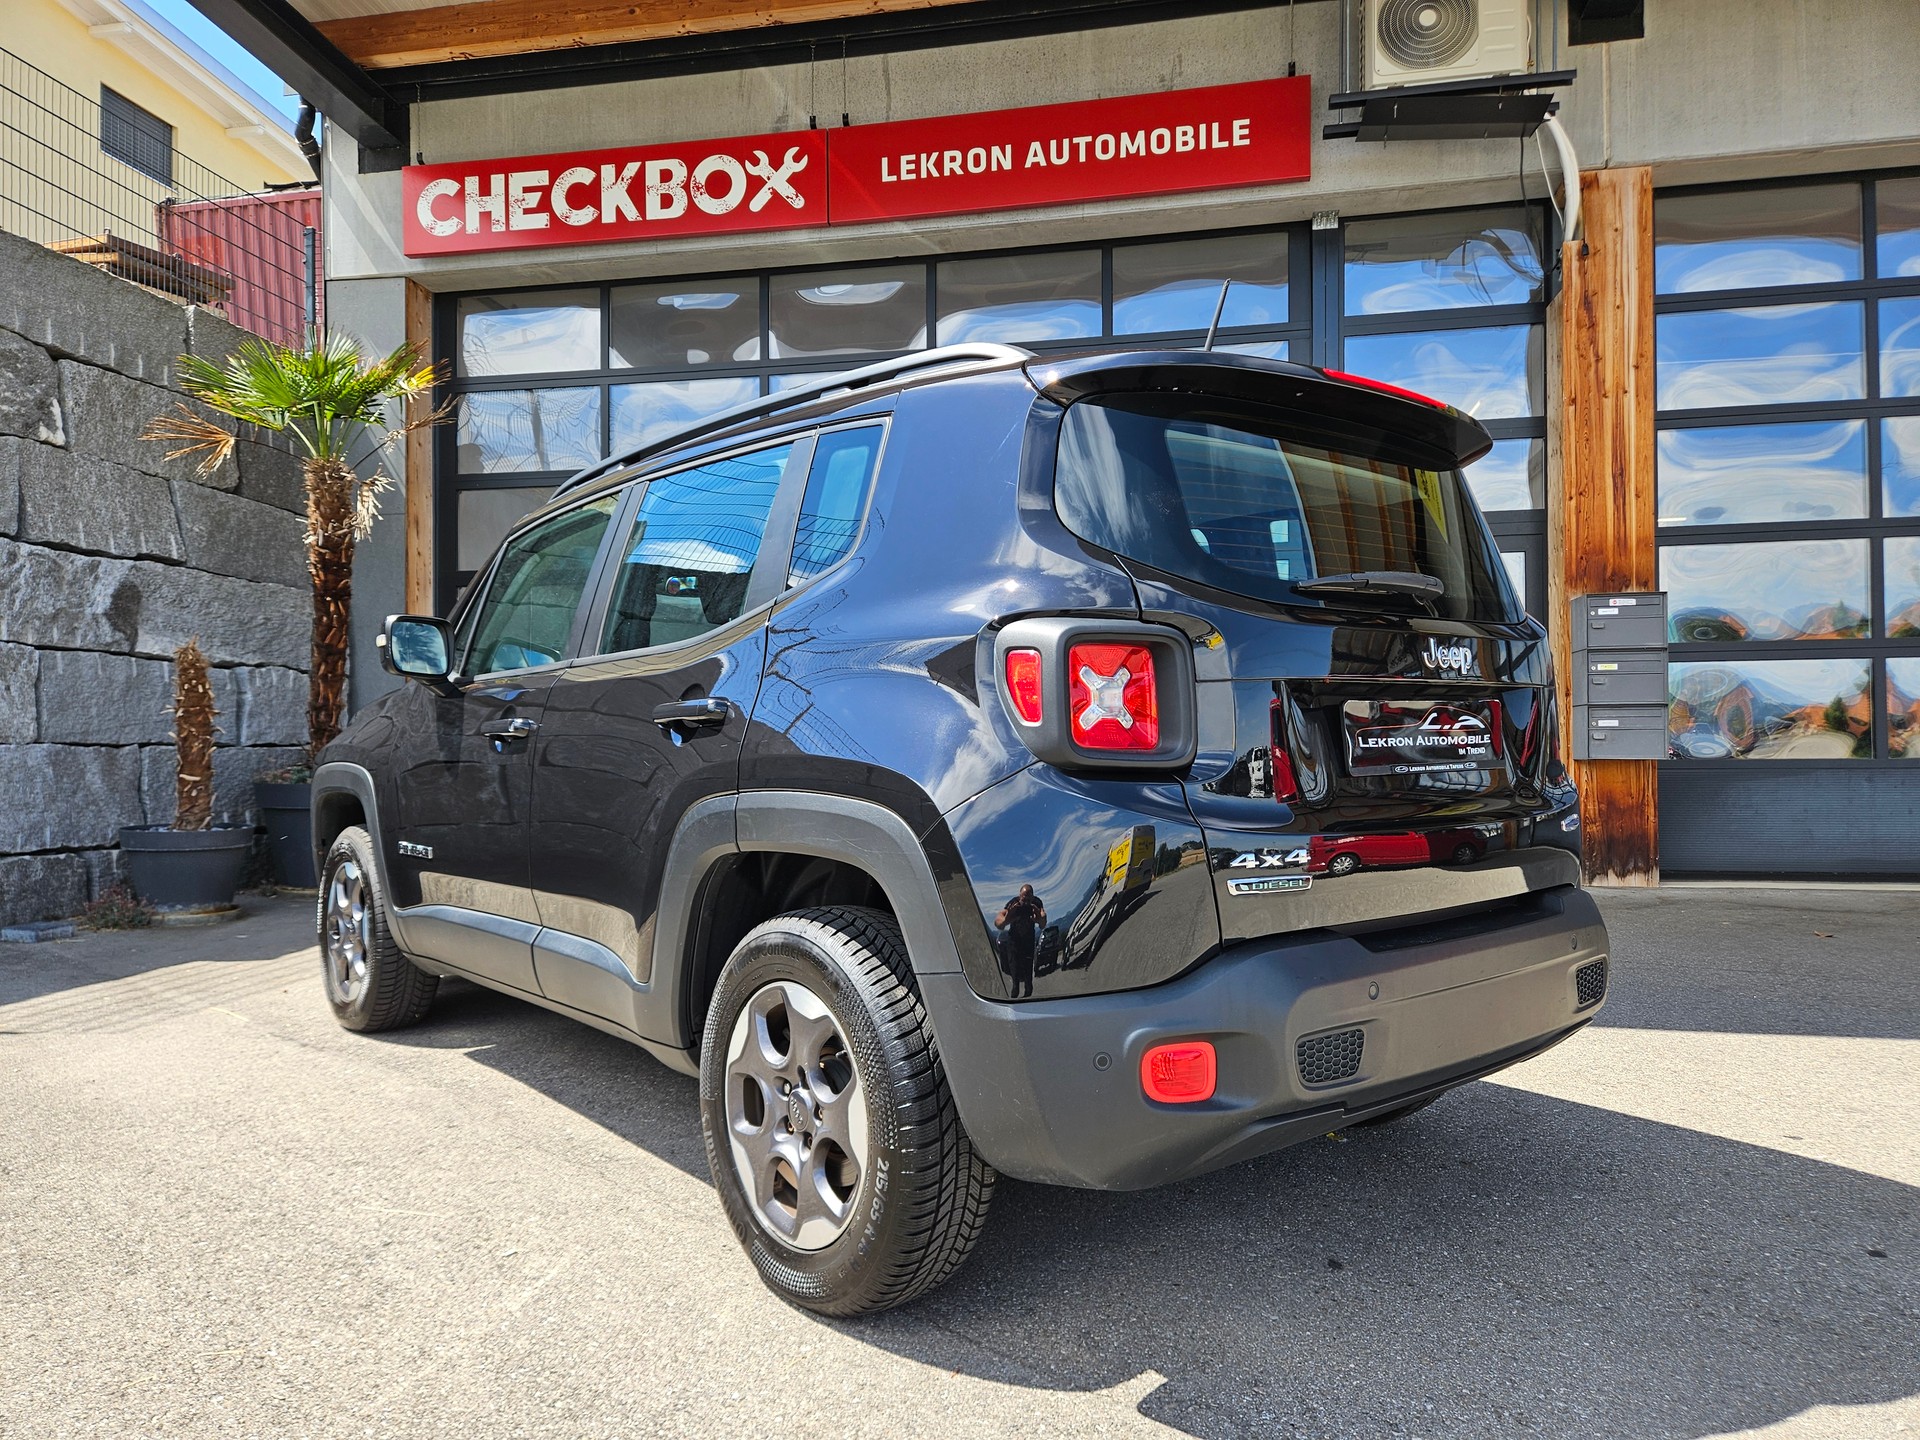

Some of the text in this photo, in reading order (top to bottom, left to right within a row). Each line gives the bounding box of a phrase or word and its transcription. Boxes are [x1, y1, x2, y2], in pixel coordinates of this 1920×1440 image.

[881, 118, 1251, 182] LEKRON AUTOMOBILE
[416, 146, 808, 236] CHECKBOX
[1422, 637, 1473, 675] Jeep
[1358, 734, 1491, 748] LEKRON AUTOMOBILE
[1230, 848, 1312, 869] 4x4
[1252, 879, 1308, 890] DIESEL
[870, 1157, 890, 1224] 215/65
